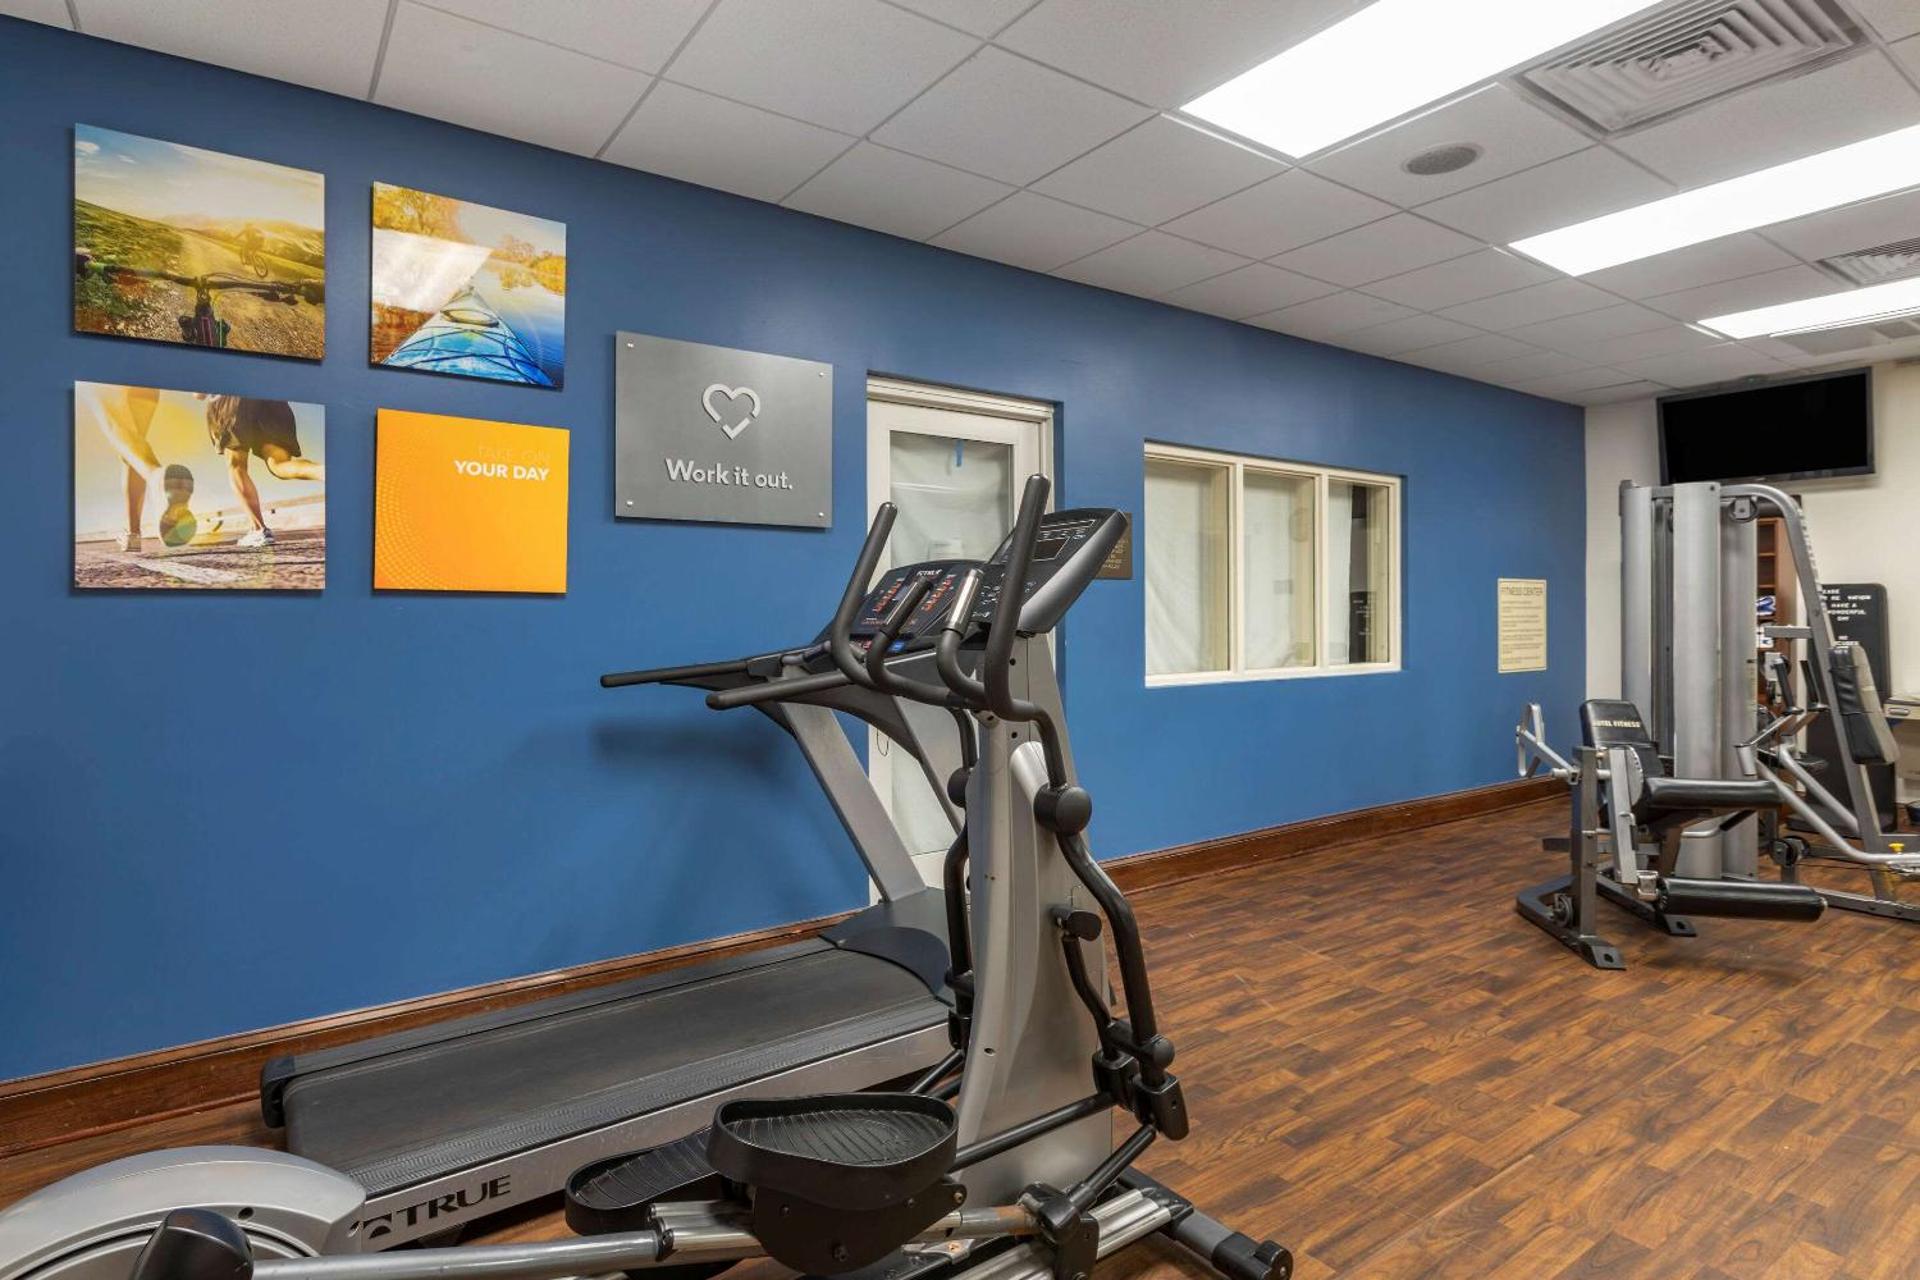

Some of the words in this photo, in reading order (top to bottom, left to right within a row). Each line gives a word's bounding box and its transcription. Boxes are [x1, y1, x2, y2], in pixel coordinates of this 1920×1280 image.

[453, 460, 508, 478] YOUR
[512, 465, 550, 480] DAY
[664, 458, 729, 485] Work
[734, 466, 749, 486] it
[754, 471, 793, 490] out.
[1613, 720, 1641, 728] FITNESS
[396, 1174, 511, 1227] TRUE
